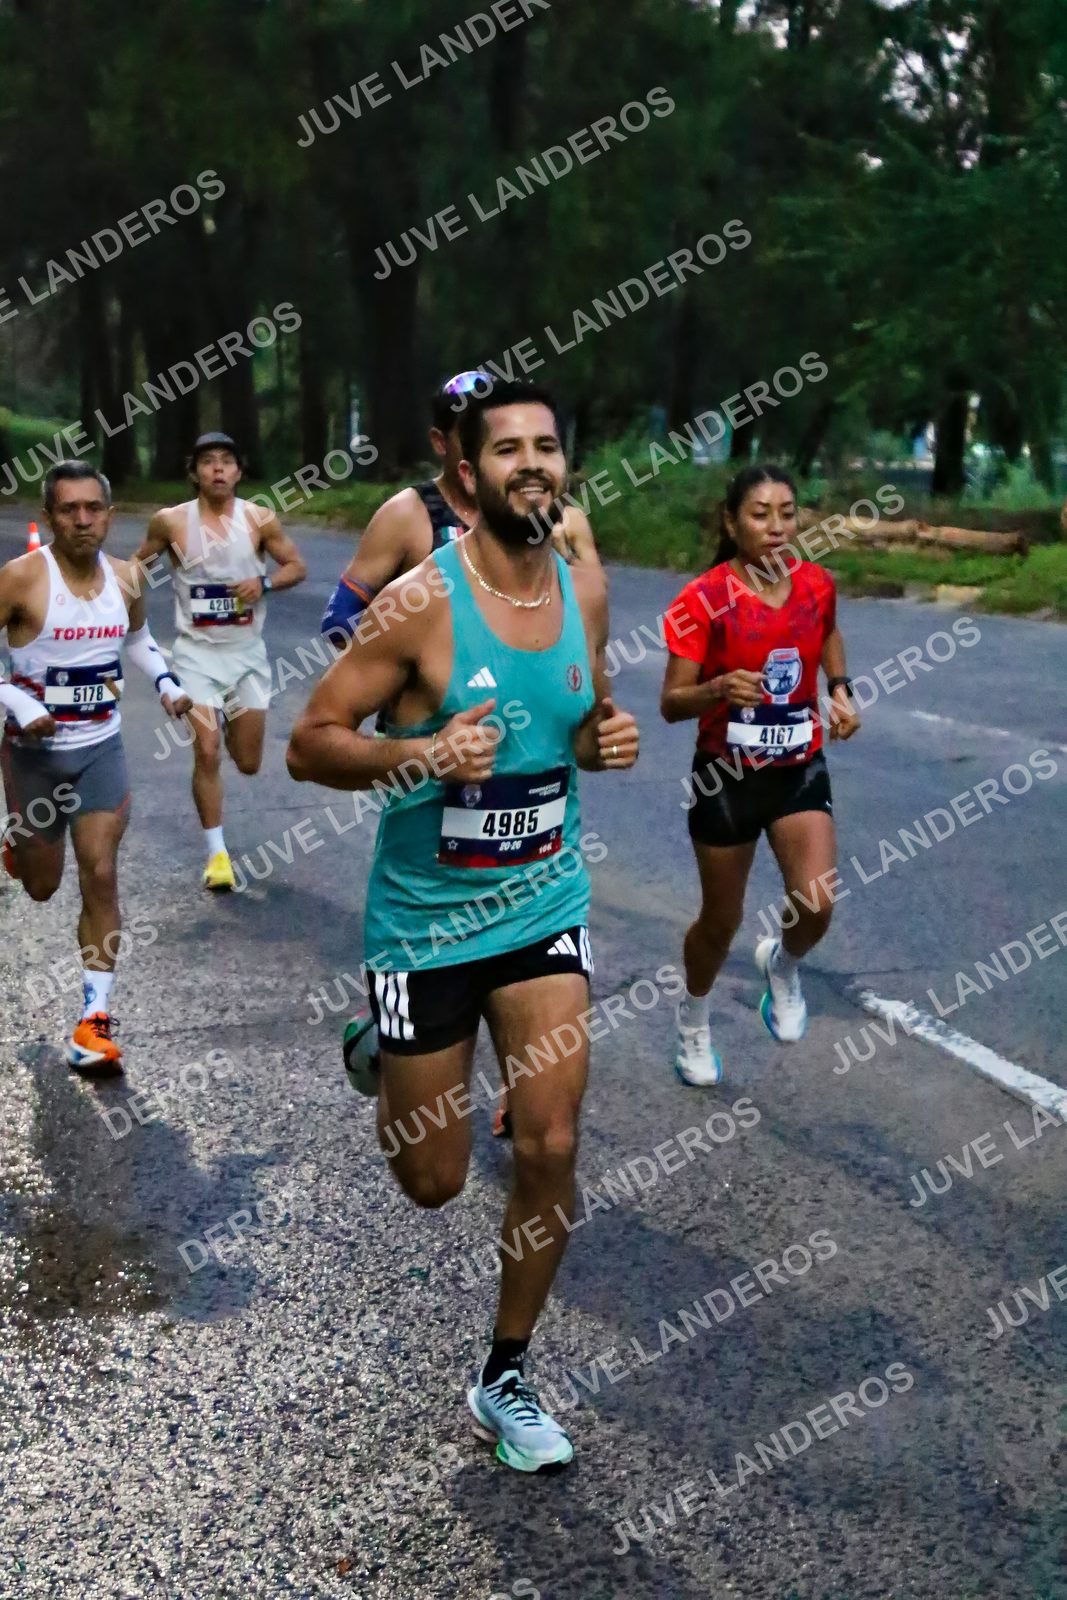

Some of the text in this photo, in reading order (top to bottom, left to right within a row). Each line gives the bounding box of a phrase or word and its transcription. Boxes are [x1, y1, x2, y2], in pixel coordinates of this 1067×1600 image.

[53, 625, 125, 640] TOPTIME
[73, 686, 104, 702] 5178
[759, 727, 794, 745] 4167
[482, 808, 539, 838] 4985
